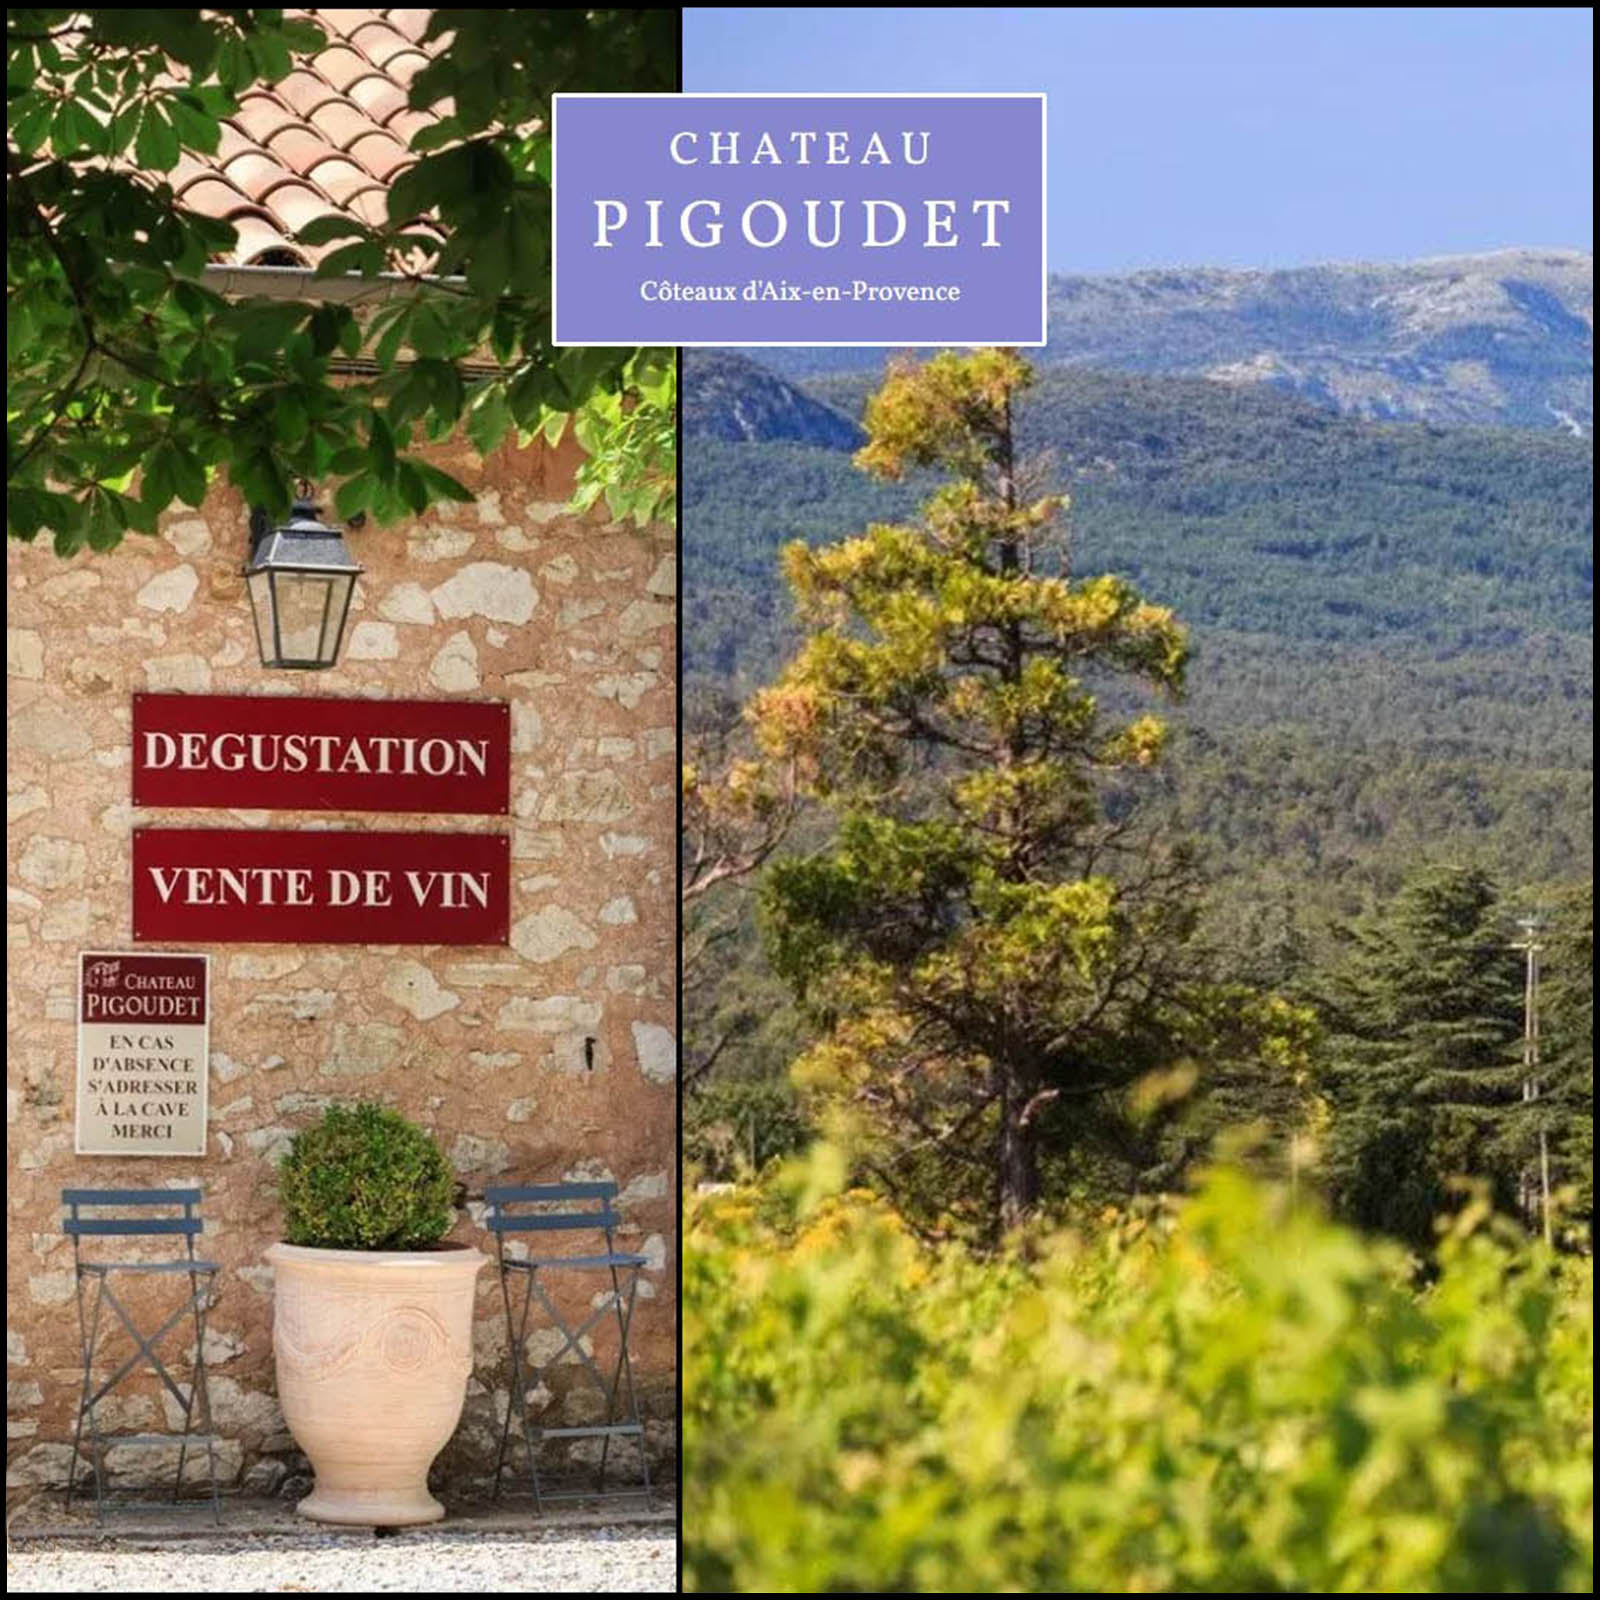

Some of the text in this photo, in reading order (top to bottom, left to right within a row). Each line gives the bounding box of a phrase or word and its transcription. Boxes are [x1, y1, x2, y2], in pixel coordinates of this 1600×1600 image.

[143, 731, 490, 776] DEGUSTATION
[149, 866, 491, 909] VENTE DE VIN
[87, 993, 200, 1017] PIGOUDET
[109, 1035, 174, 1050] EN CAS
[93, 1057, 195, 1073] D'ABSENCE
[88, 1080, 198, 1095] S'ADRESSER
[96, 1098, 190, 1117] À LA CAVE
[111, 1124, 174, 1139] MERCI
